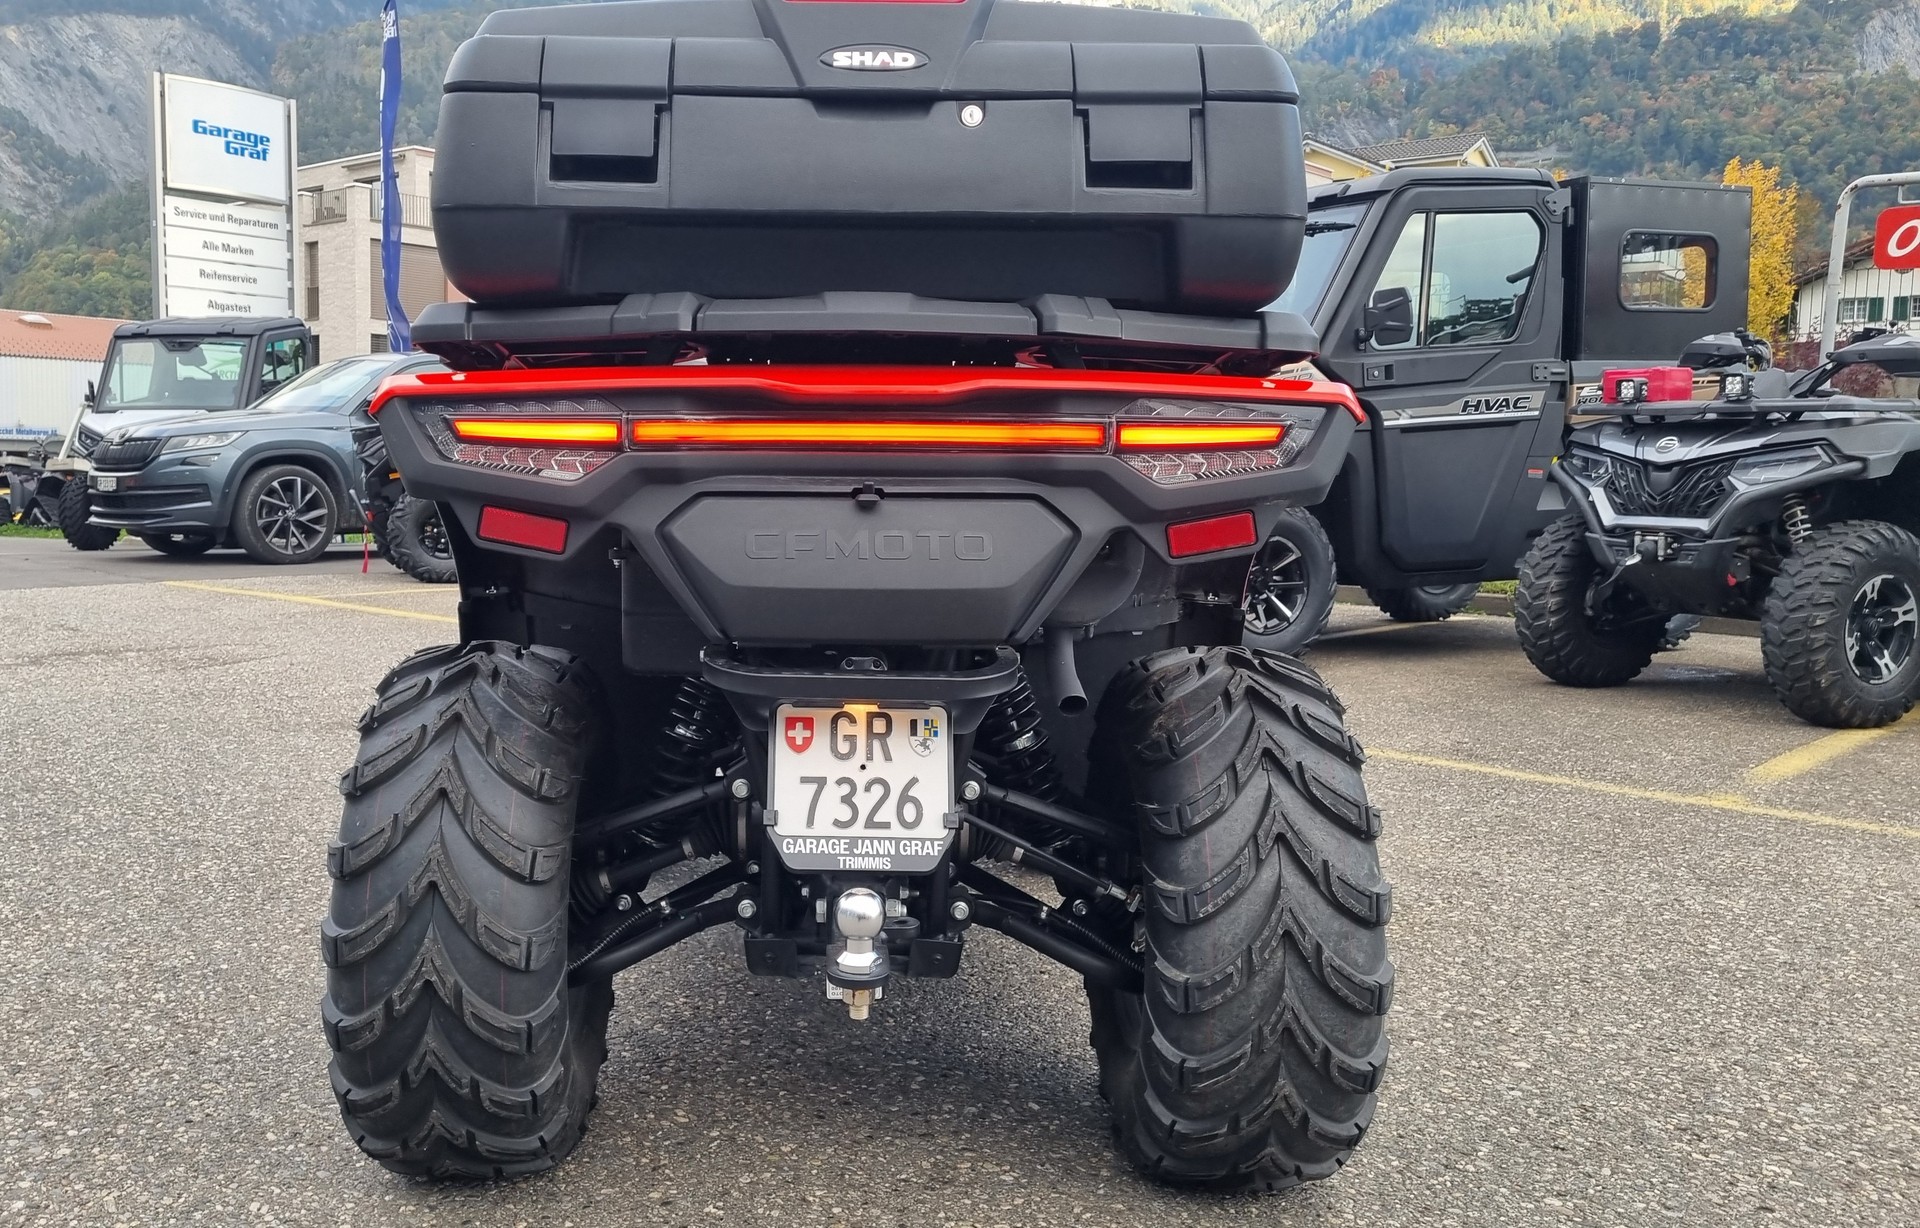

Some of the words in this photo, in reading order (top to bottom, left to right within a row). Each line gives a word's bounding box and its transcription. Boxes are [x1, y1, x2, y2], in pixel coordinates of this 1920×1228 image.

[832, 52, 916, 67] SHAD
[192, 119, 270, 148] Garage
[224, 140, 269, 161] Graf
[173, 206, 207, 220] Service
[209, 213, 225, 223] und
[227, 214, 279, 230] Reparaturen
[202, 240, 220, 252] Alle
[221, 242, 254, 256] Marken
[199, 268, 258, 285] Reifenservice
[207, 299, 252, 313] Abgastest
[1459, 395, 1532, 414] HVAC
[744, 529, 993, 561] CFMOTO
[830, 711, 893, 762] GR
[800, 776, 924, 829] 7326
[782, 838, 850, 855] GARAGE
[852, 839, 896, 856] JANN
[899, 840, 944, 856] GRAF
[837, 856, 891, 870] TRIMMIS
